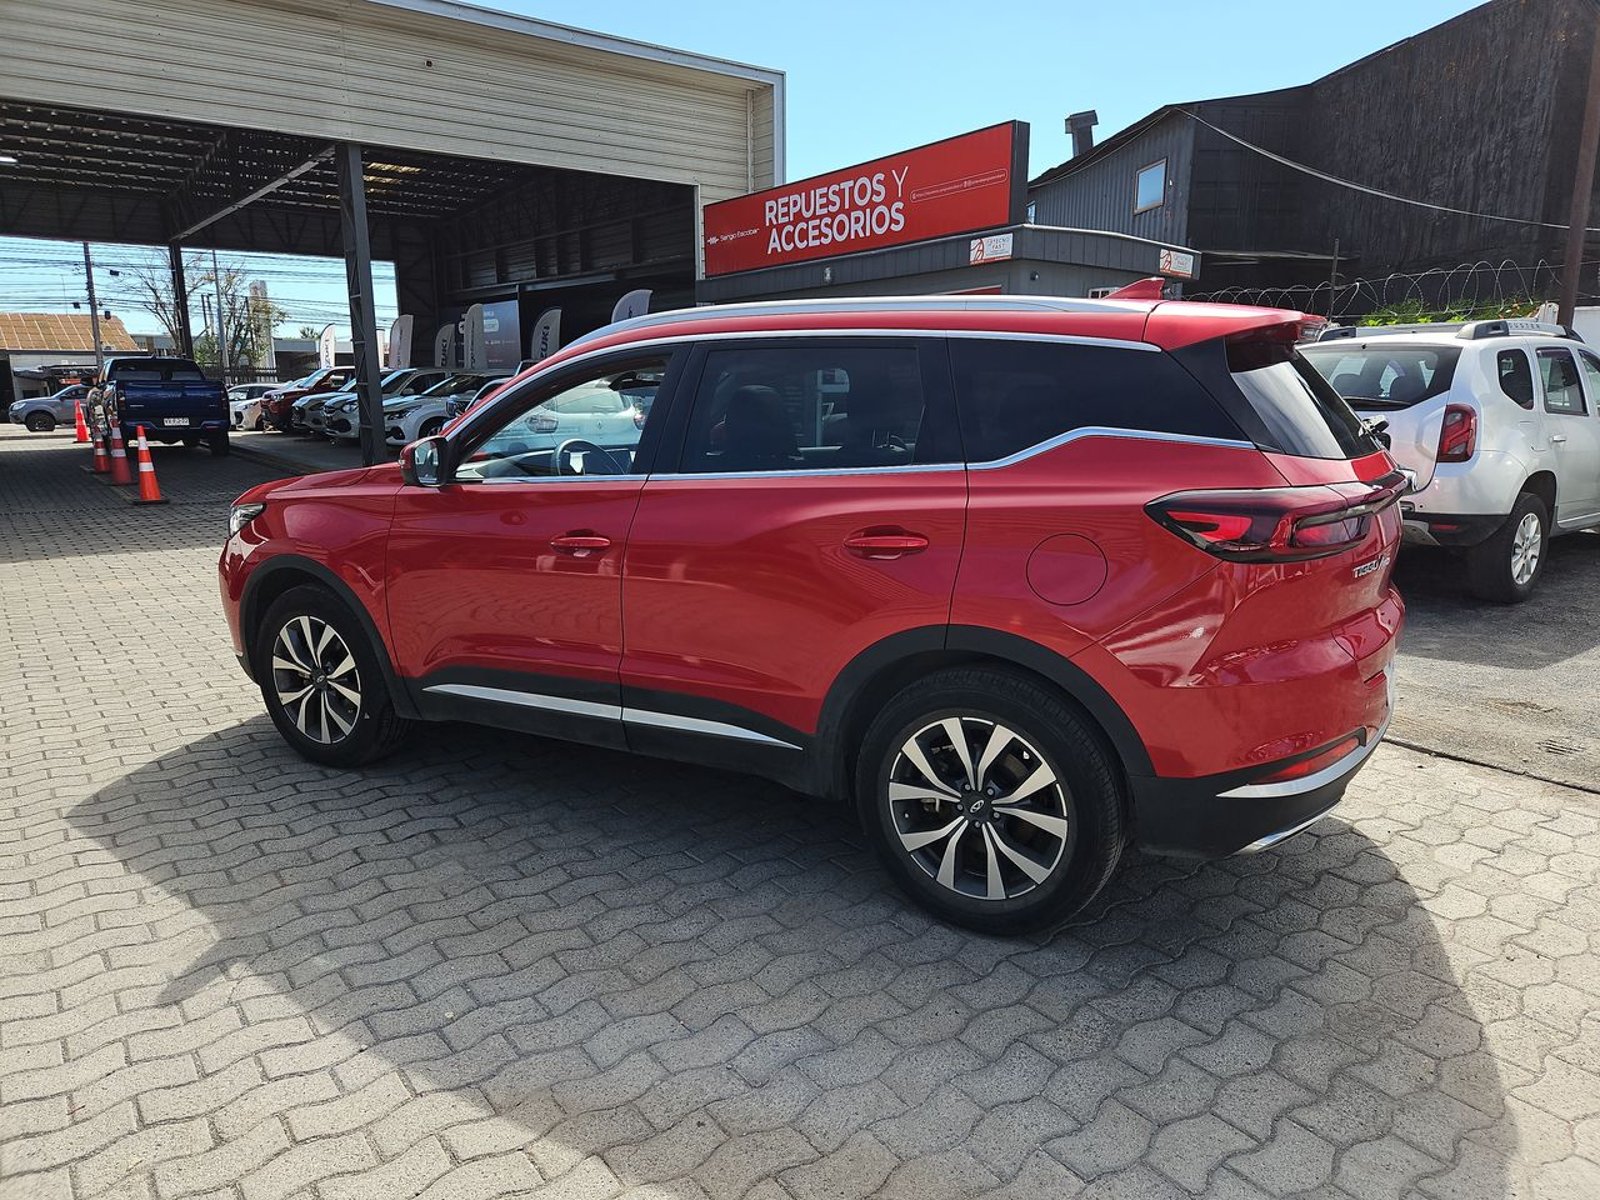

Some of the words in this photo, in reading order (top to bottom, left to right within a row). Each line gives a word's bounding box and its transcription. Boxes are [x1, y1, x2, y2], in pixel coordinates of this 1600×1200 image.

[765, 173, 886, 226] REPUESTOS
[891, 166, 909, 198] Y
[767, 201, 905, 255] ACCESORIOS
